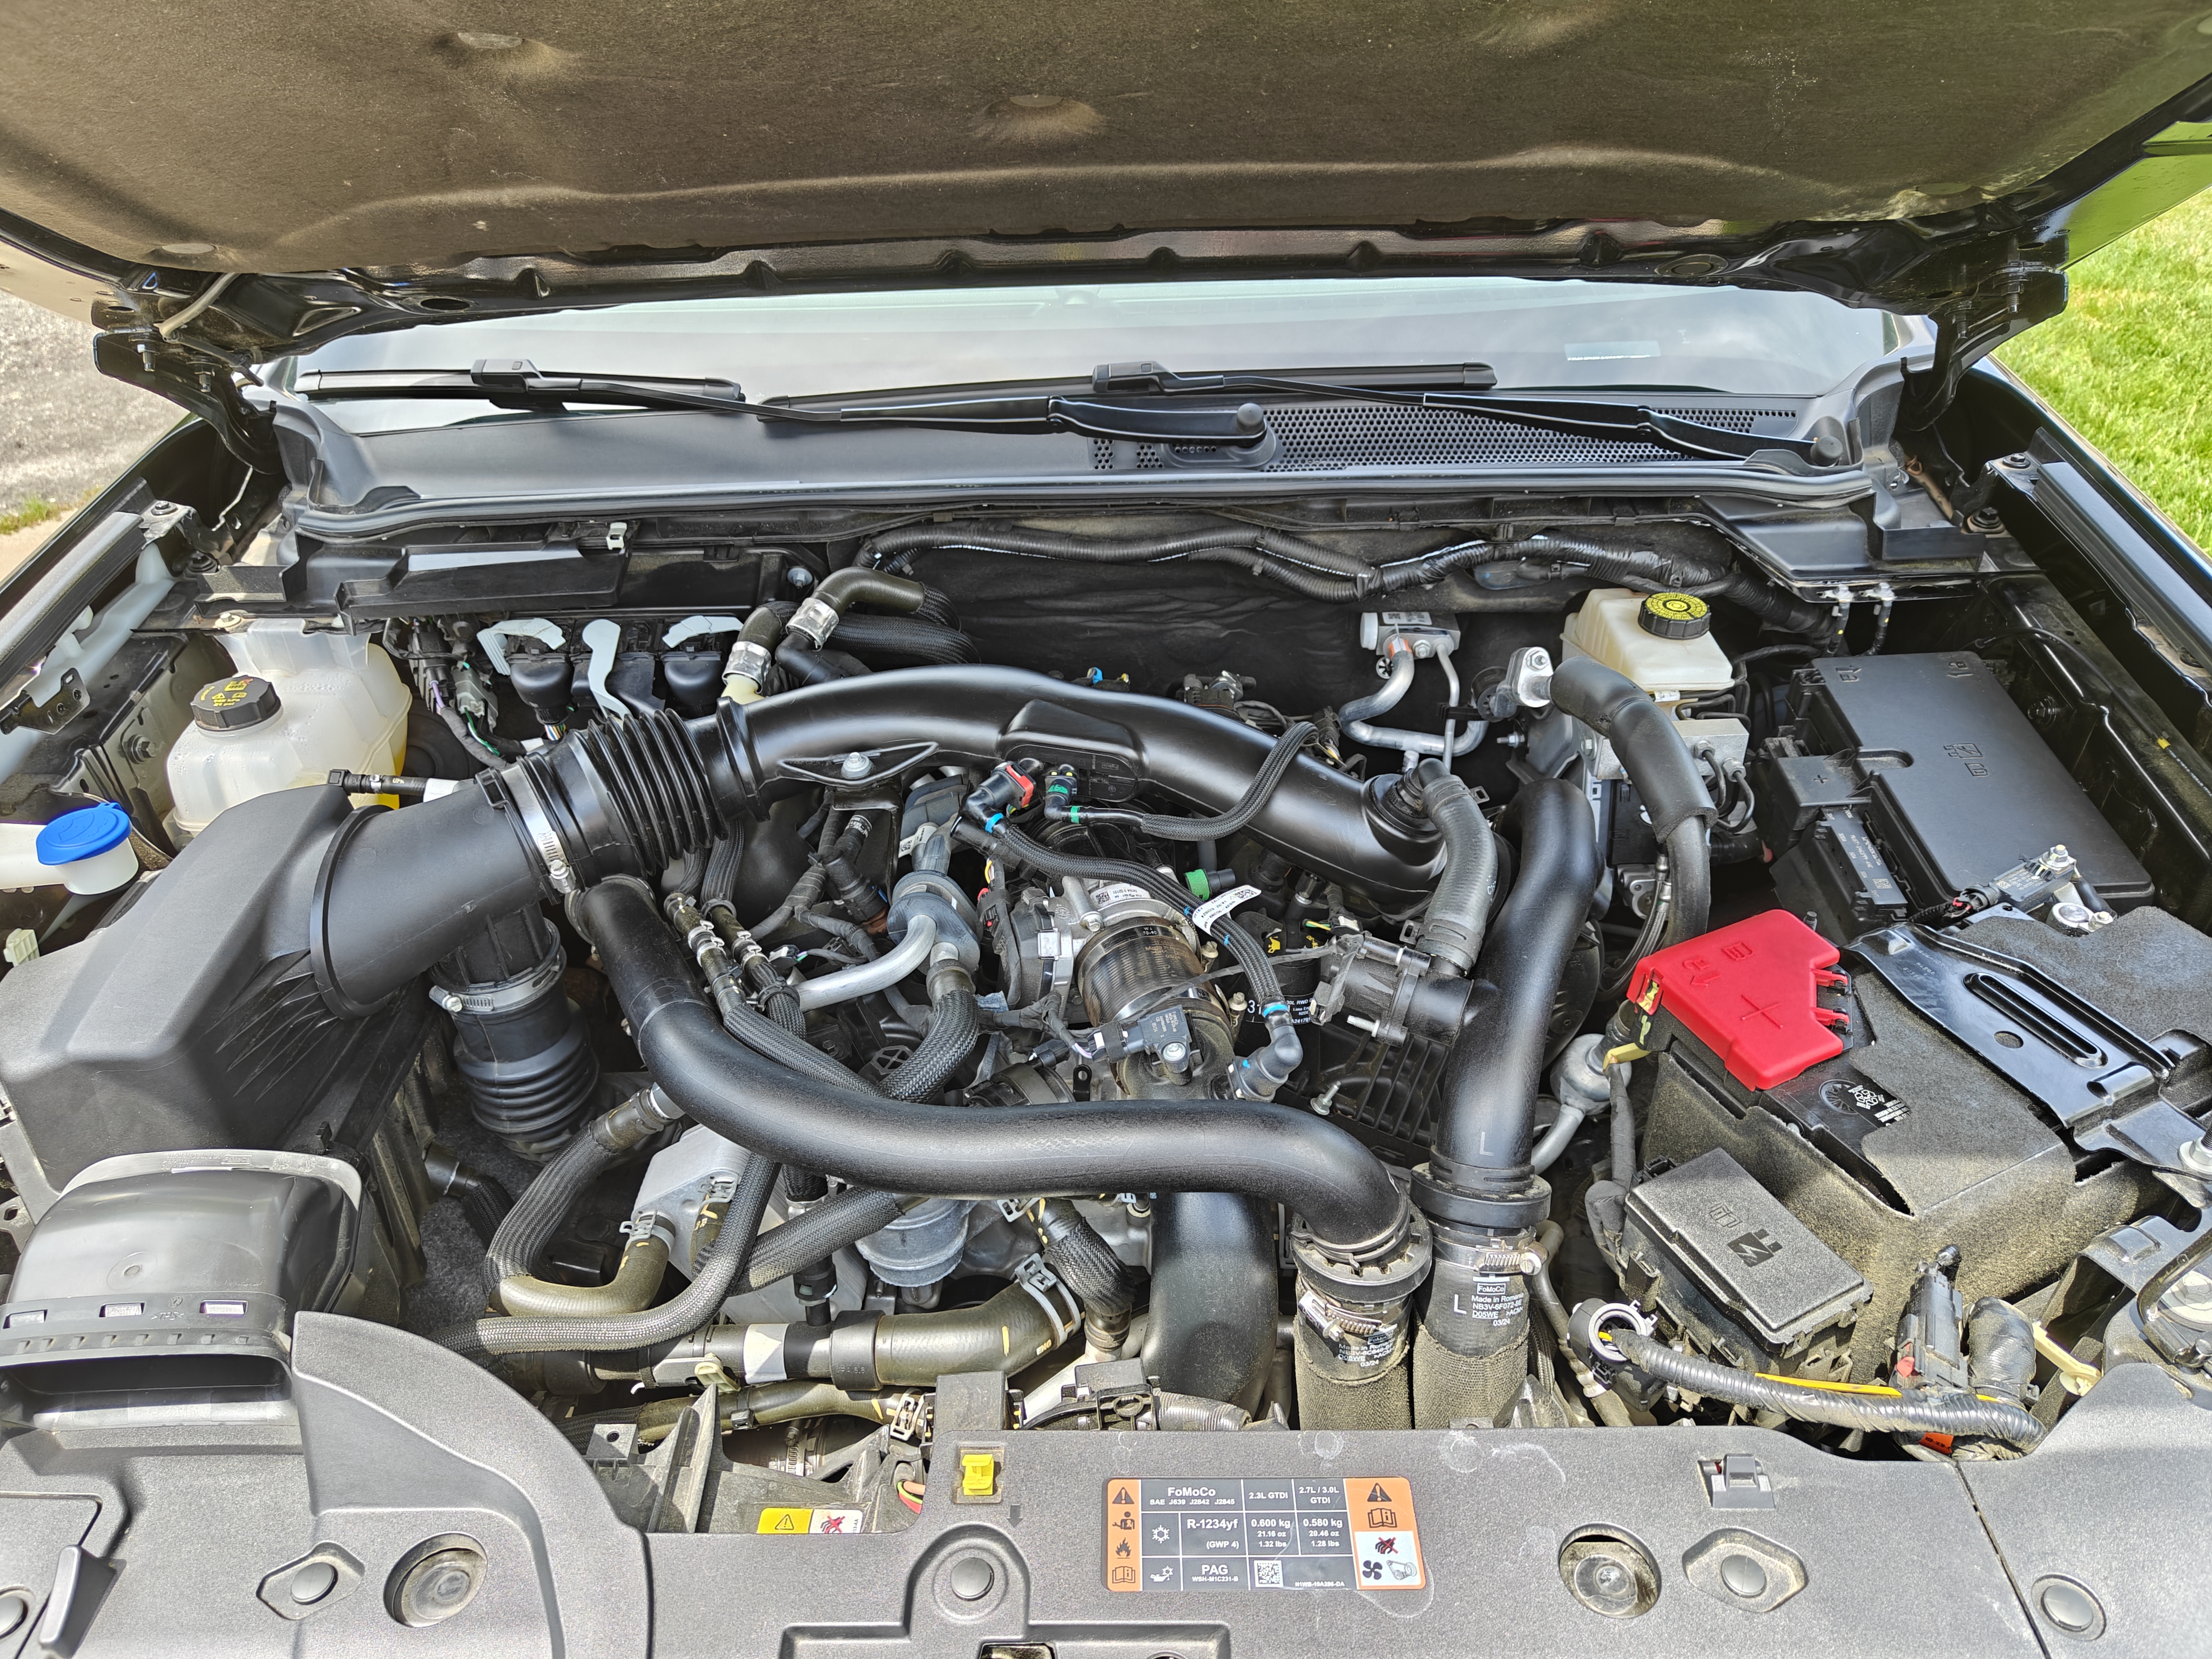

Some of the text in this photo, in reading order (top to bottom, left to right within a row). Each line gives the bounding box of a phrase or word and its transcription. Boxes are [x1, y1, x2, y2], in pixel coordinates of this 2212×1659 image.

[1480, 1131, 1495, 1156] L
[1454, 1294, 1467, 1314] L
[1493, 1318, 1510, 1326] 03/24
[1369, 1332, 1392, 1343] FoMoCo
[1168, 1487, 1216, 1496] FoMoCo
[1187, 1518, 1238, 1531] R-1234yf
[1251, 1519, 1291, 1529] 0.600 kg
[1303, 1518, 1343, 1528] 0.580 kg
[1206, 1541, 1239, 1549] (GWP 4)
[1202, 1564, 1228, 1575] PAG
